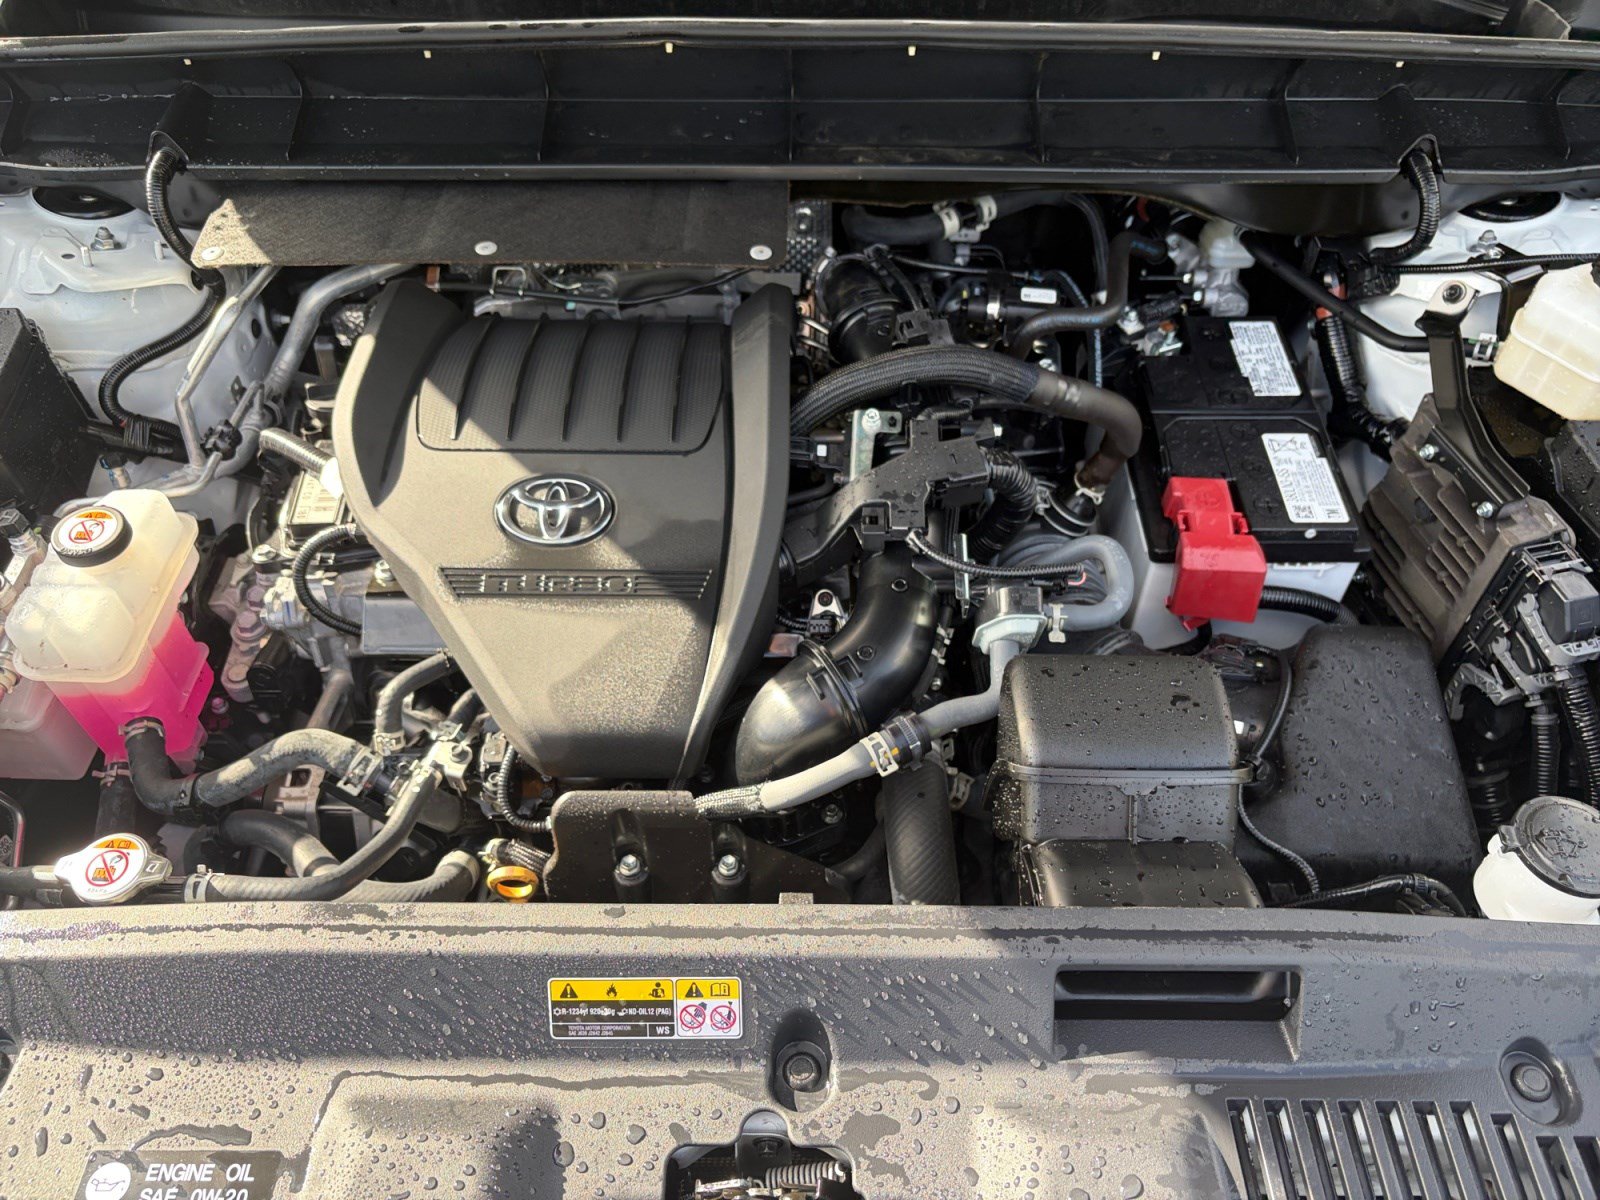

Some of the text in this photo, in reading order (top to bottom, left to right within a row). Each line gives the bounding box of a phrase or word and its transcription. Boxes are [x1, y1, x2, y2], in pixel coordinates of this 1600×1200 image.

[628, 1007, 654, 1016] ND-OIL12
[655, 1007, 672, 1017] (PAG)
[655, 1026, 670, 1035] WS
[145, 1163, 255, 1182] ENGINE OIL
[138, 1187, 249, 1200] SAE 0W-20
